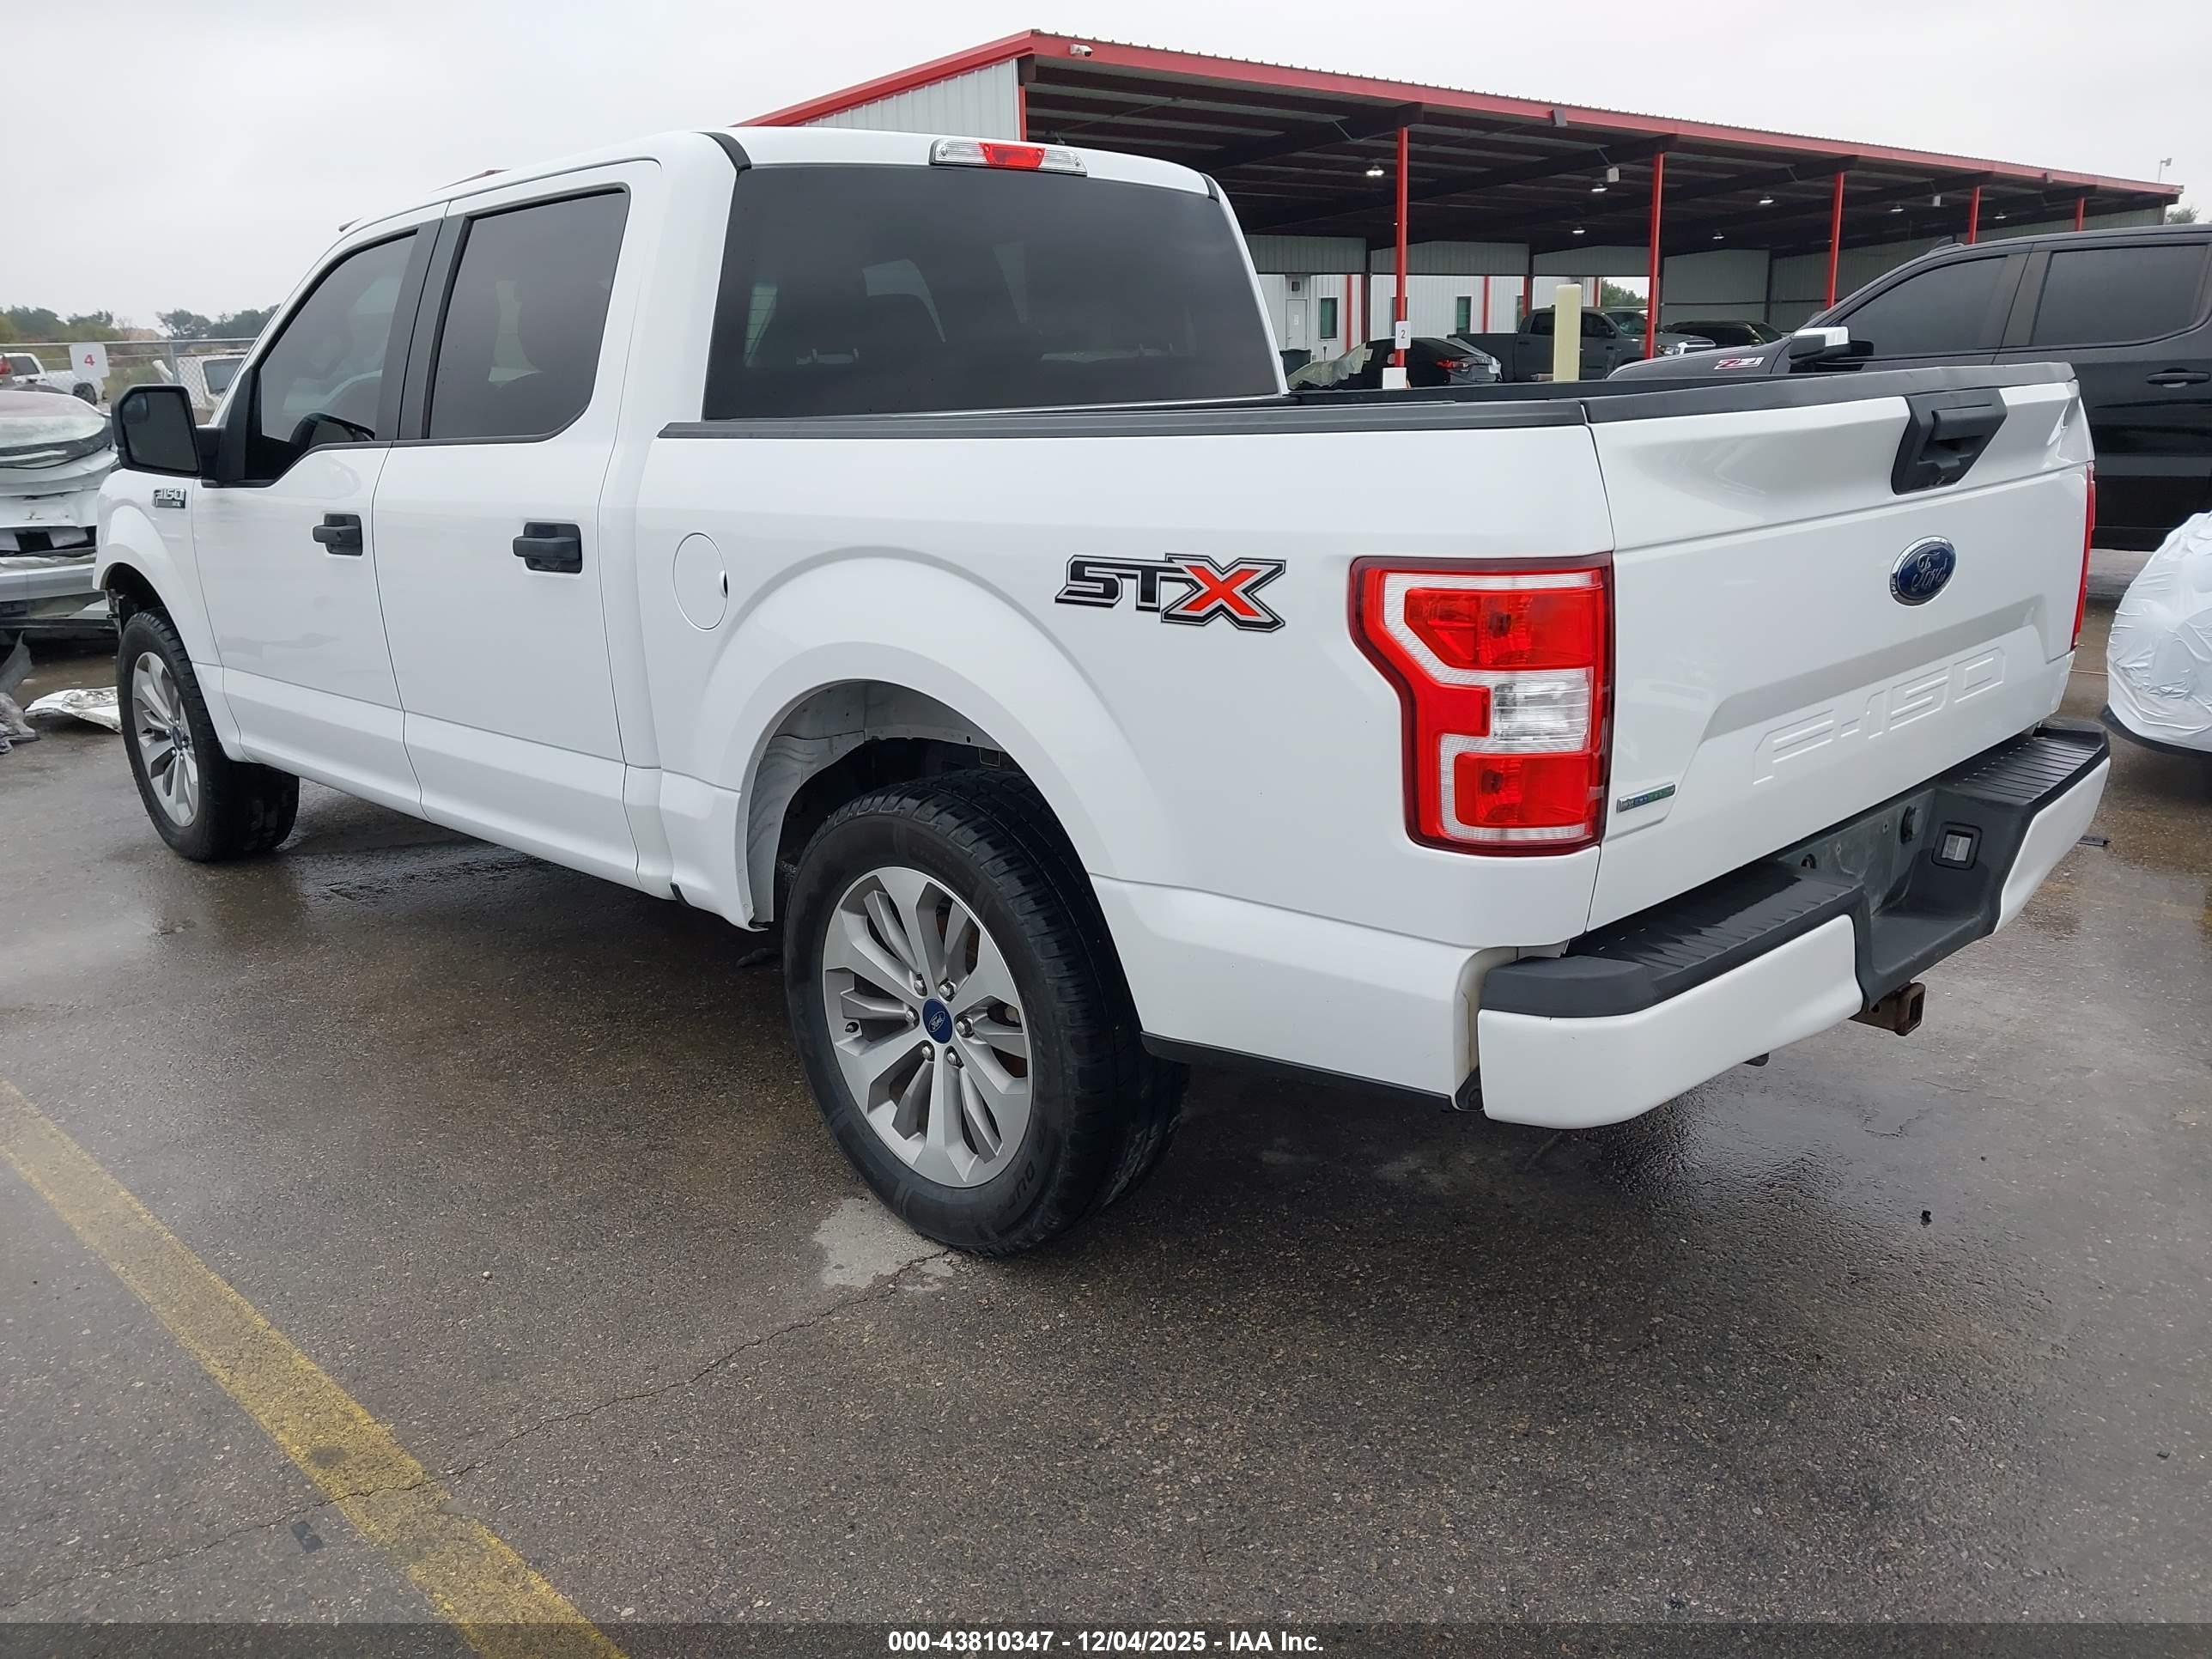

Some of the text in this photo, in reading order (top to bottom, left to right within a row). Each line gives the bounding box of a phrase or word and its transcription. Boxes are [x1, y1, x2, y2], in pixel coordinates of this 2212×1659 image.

[1401, 329, 1407, 339] 2
[83, 354, 95, 366] 4
[1714, 356, 1765, 370] Z71
[1054, 552, 1287, 633] STX
[1753, 646, 2006, 785] F-150
